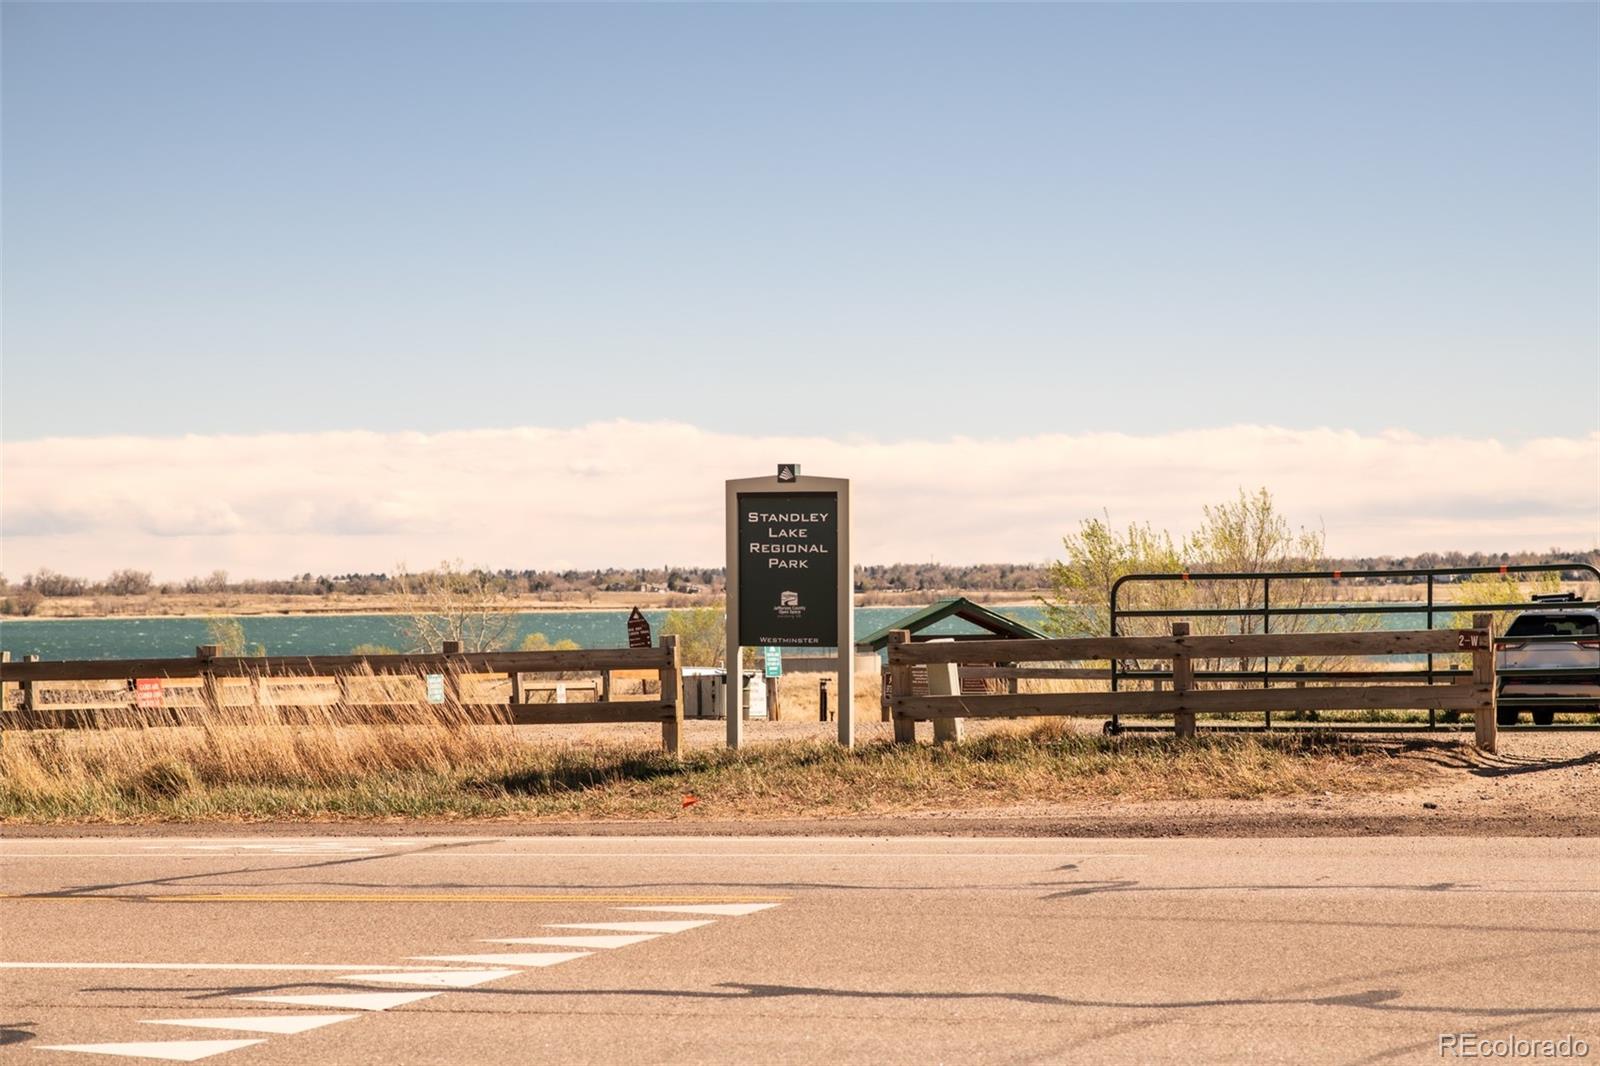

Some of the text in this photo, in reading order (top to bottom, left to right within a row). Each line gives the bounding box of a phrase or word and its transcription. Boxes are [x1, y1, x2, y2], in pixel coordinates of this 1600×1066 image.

[748, 512, 829, 523] STANDLEY
[768, 528, 808, 538] LAKE
[750, 543, 828, 553] REGIONAL
[768, 558, 809, 569] PARK
[759, 636, 819, 644] WESTMINSTER
[1458, 634, 1479, 647] 2-W
